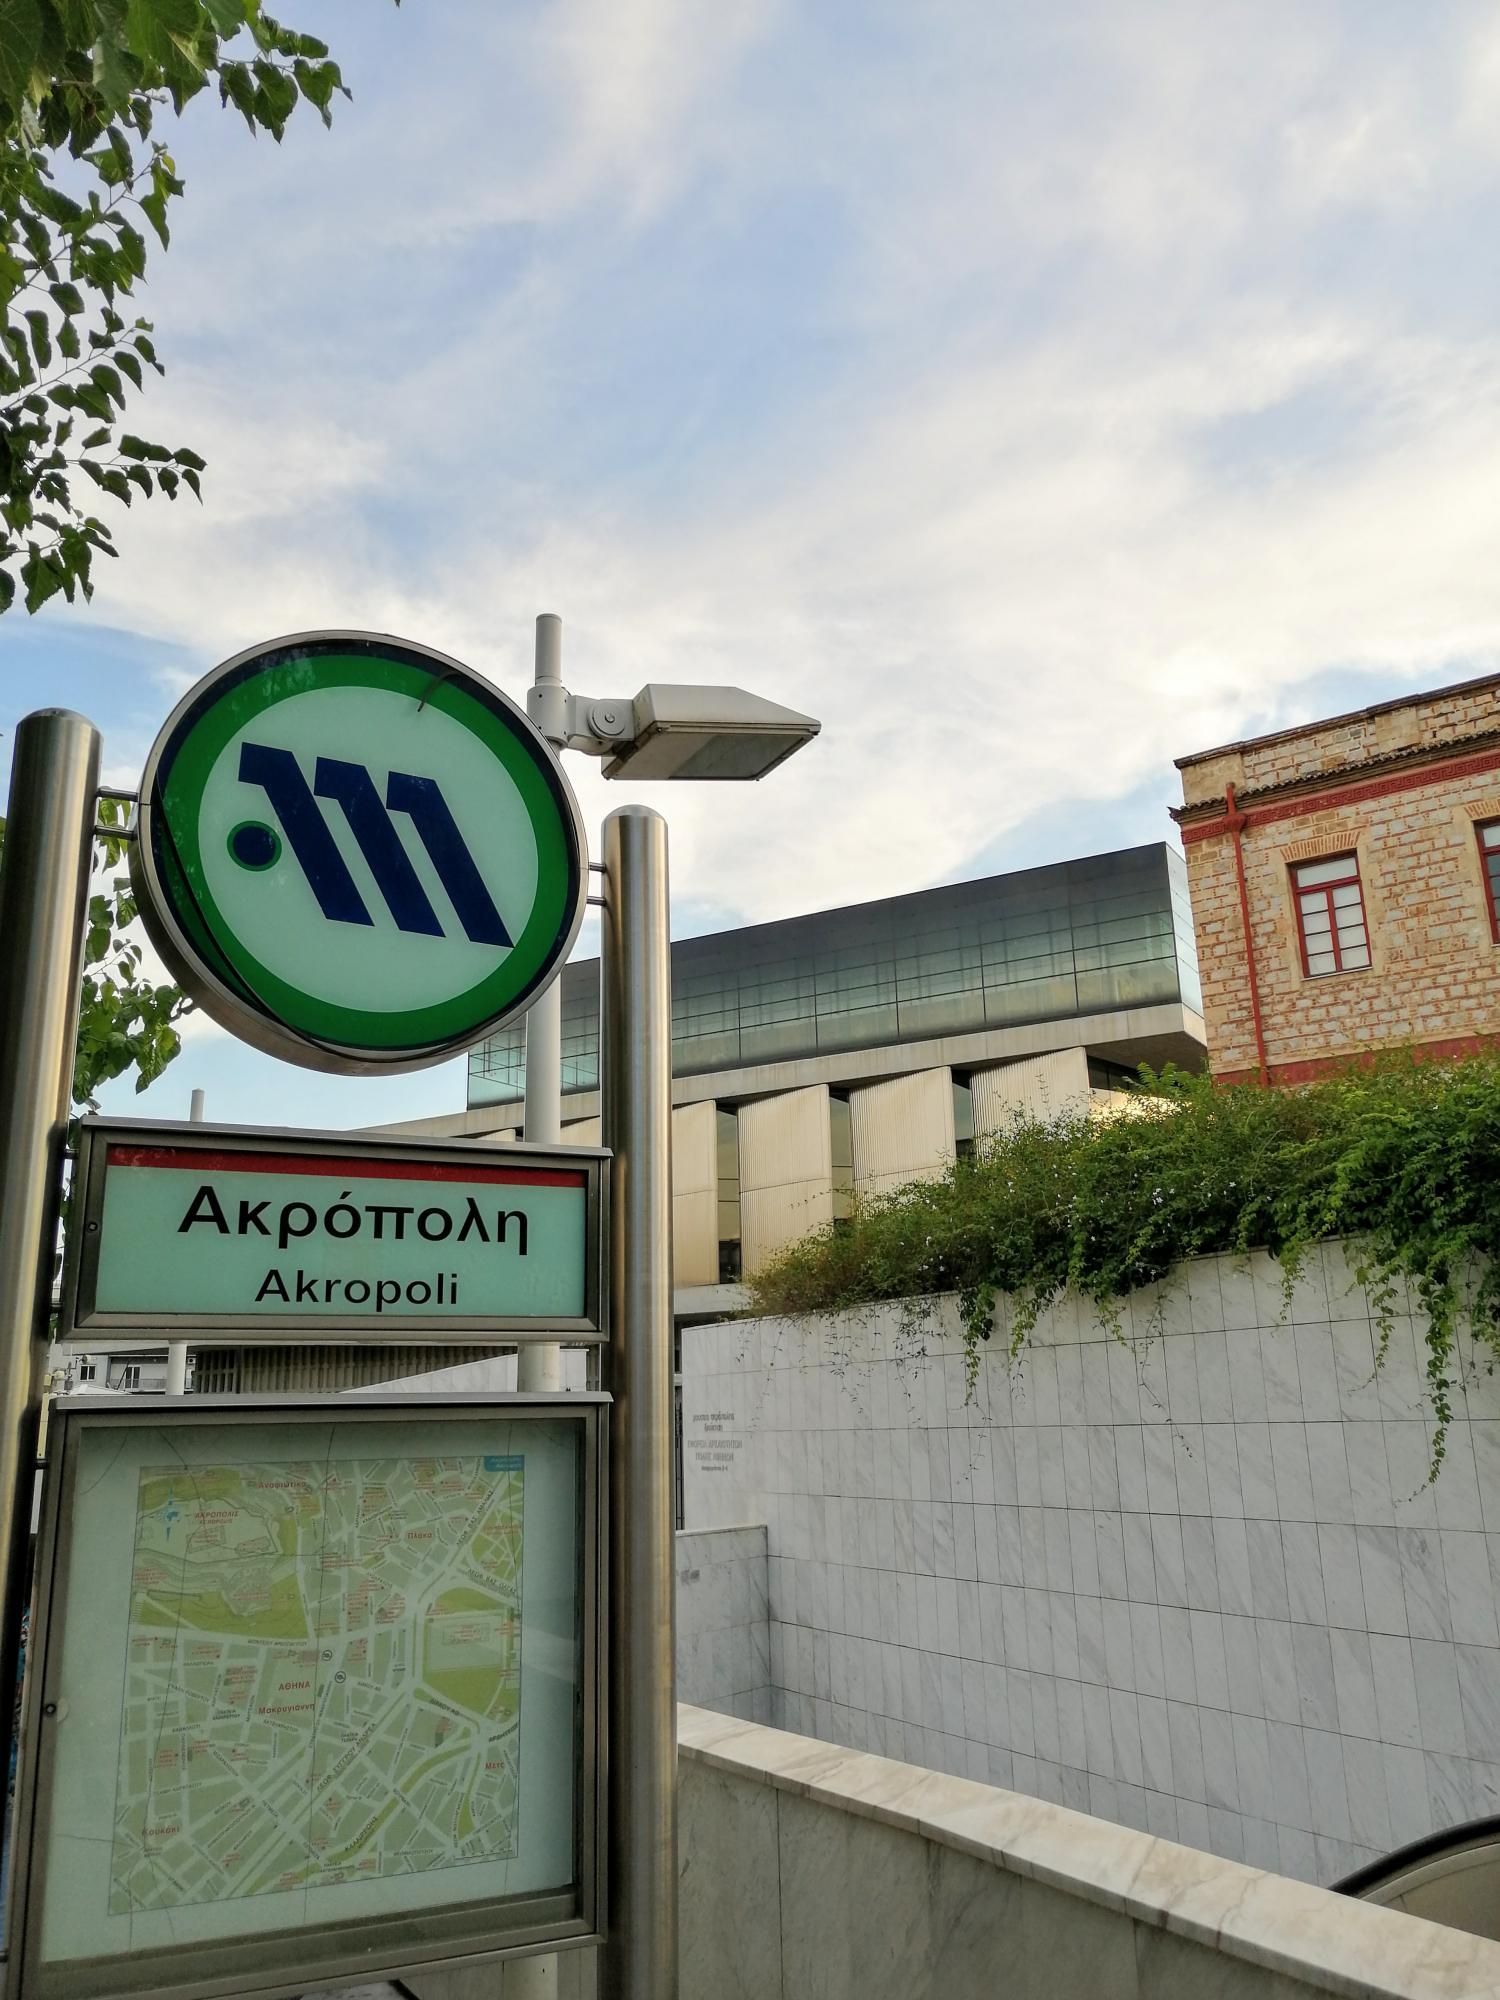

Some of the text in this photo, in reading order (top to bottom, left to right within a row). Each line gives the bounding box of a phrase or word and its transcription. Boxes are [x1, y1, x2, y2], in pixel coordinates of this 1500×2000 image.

[178, 1184, 530, 1256] Ακρόπολη
[255, 1269, 458, 1312] Akropoli
[278, 1680, 311, 1691] ΑΘΗΝΑ
